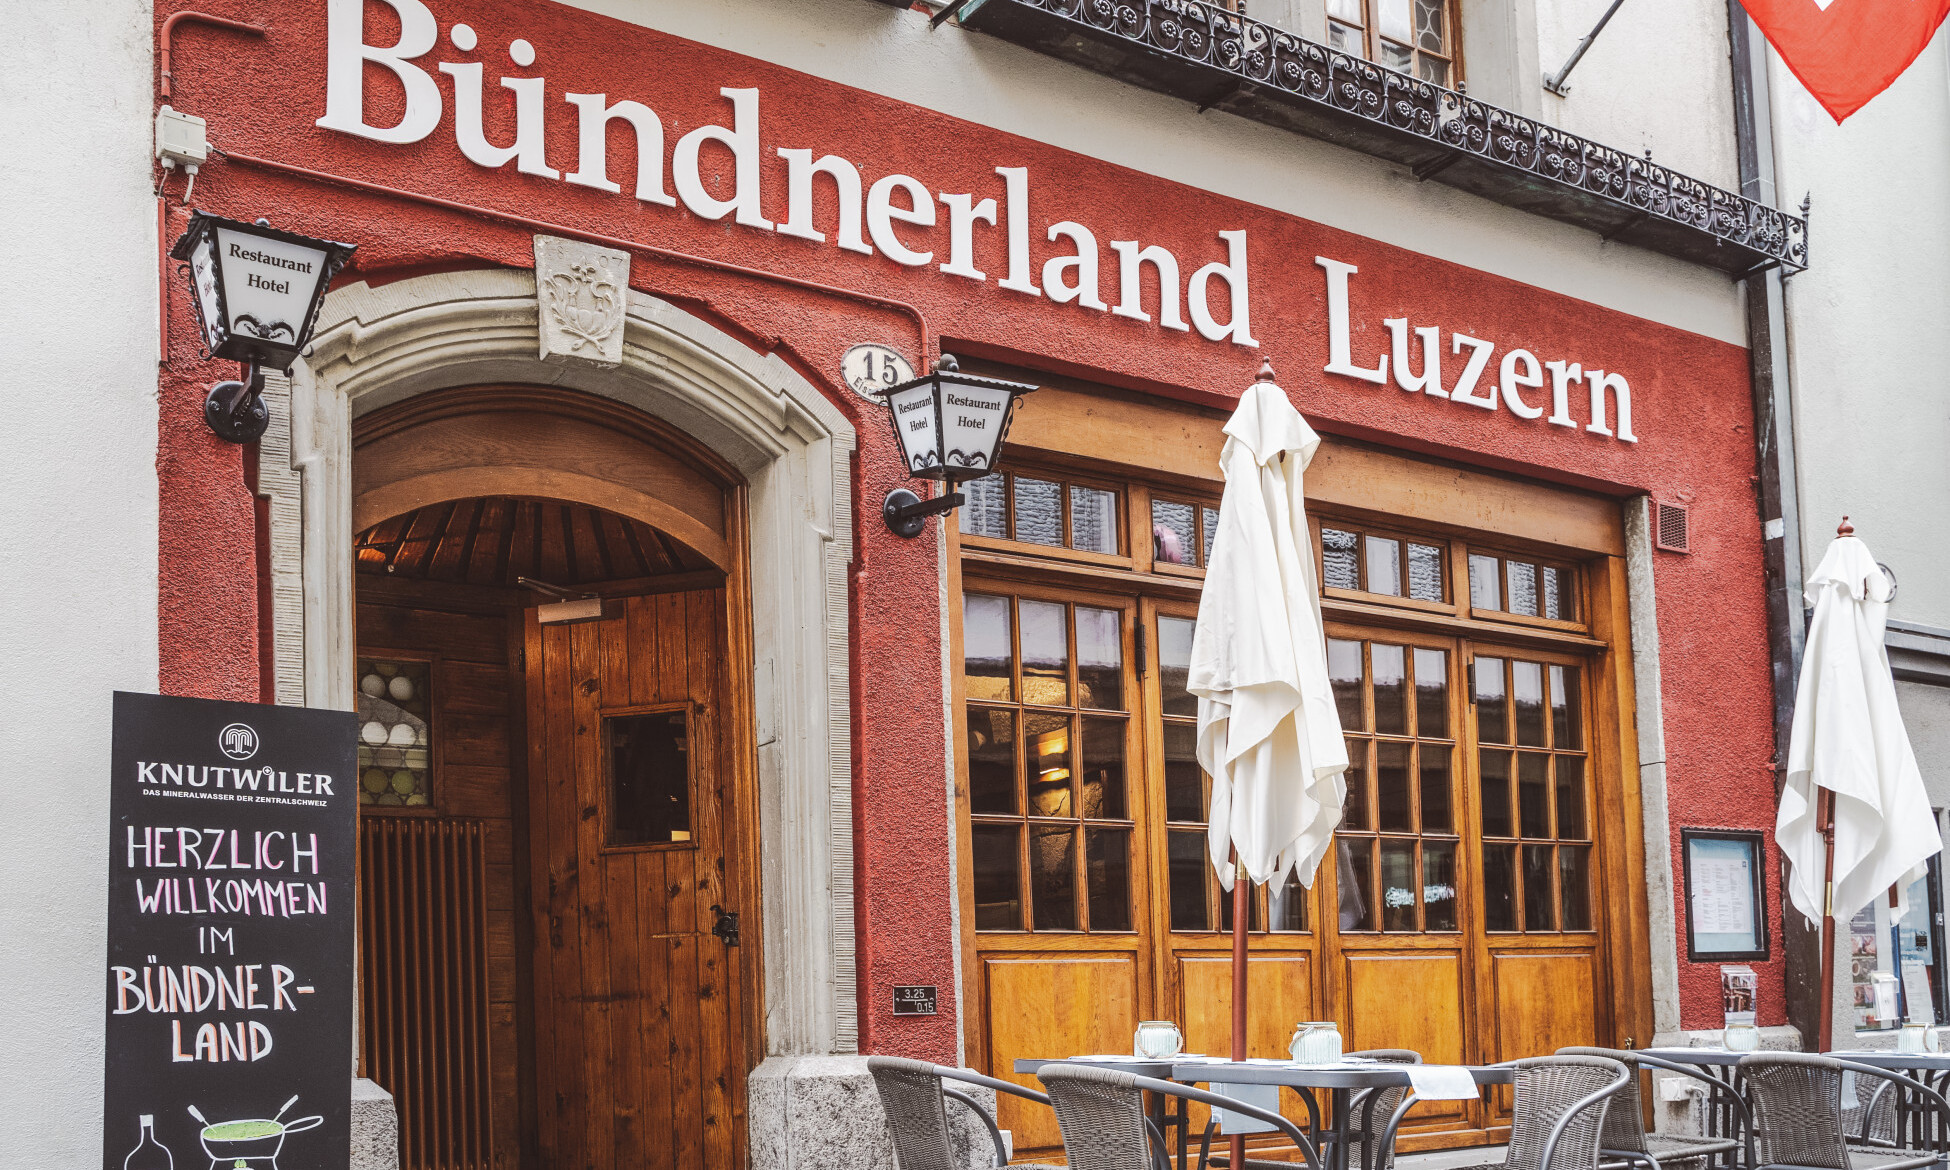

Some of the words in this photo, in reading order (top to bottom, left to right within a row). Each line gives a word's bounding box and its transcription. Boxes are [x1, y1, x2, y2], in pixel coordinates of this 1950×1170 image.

[316, 0, 1260, 348] Bündnerland
[1314, 255, 1638, 444] Luzern
[229, 243, 313, 275] Restaurant
[247, 273, 290, 295] Hotel
[863, 350, 899, 386] 15
[898, 396, 933, 415] Restaurant
[946, 393, 1002, 411] Restaurant
[909, 417, 928, 432] Hotel
[957, 416, 986, 430] Hotel
[142, 788, 161, 797] DAS
[162, 790, 235, 802] MINERALWASSER
[236, 794, 254, 803] DER
[255, 795, 328, 807] ZENTRALSCHWEIZ
[127, 825, 319, 875] HERZLICH
[136, 877, 327, 919] WILLKOMMEN
[199, 926, 235, 956] IM
[110, 954, 316, 1015] BÜNDNER-
[904, 988, 925, 999] 3.25
[916, 1002, 934, 1013] 0.15
[172, 1019, 273, 1063] LAND
